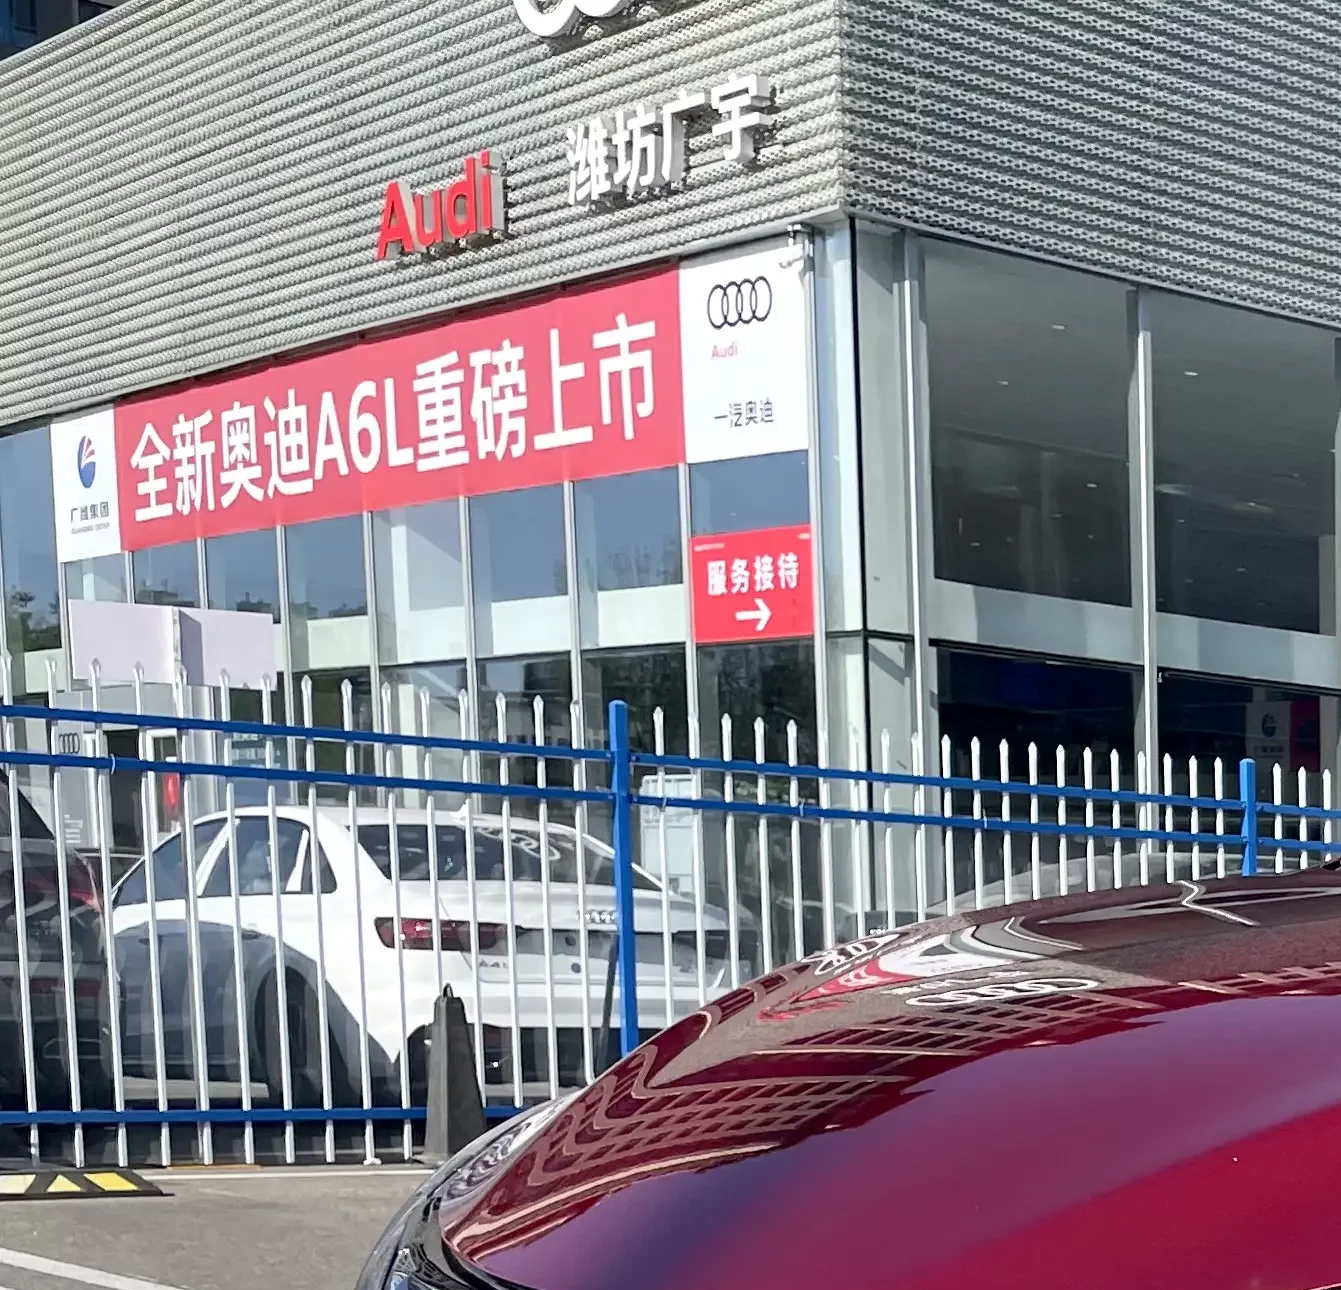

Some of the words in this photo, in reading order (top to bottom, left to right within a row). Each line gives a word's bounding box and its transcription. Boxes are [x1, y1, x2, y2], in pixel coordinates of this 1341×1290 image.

[565, 72, 773, 205] 潍坊广宇
[376, 149, 497, 260] Audi
[711, 341, 738, 359] Audi
[129, 312, 657, 522] 全新奥迪A6L重磅上市
[714, 398, 774, 428] 一汽奥迪
[707, 552, 799, 596] 服务接待
